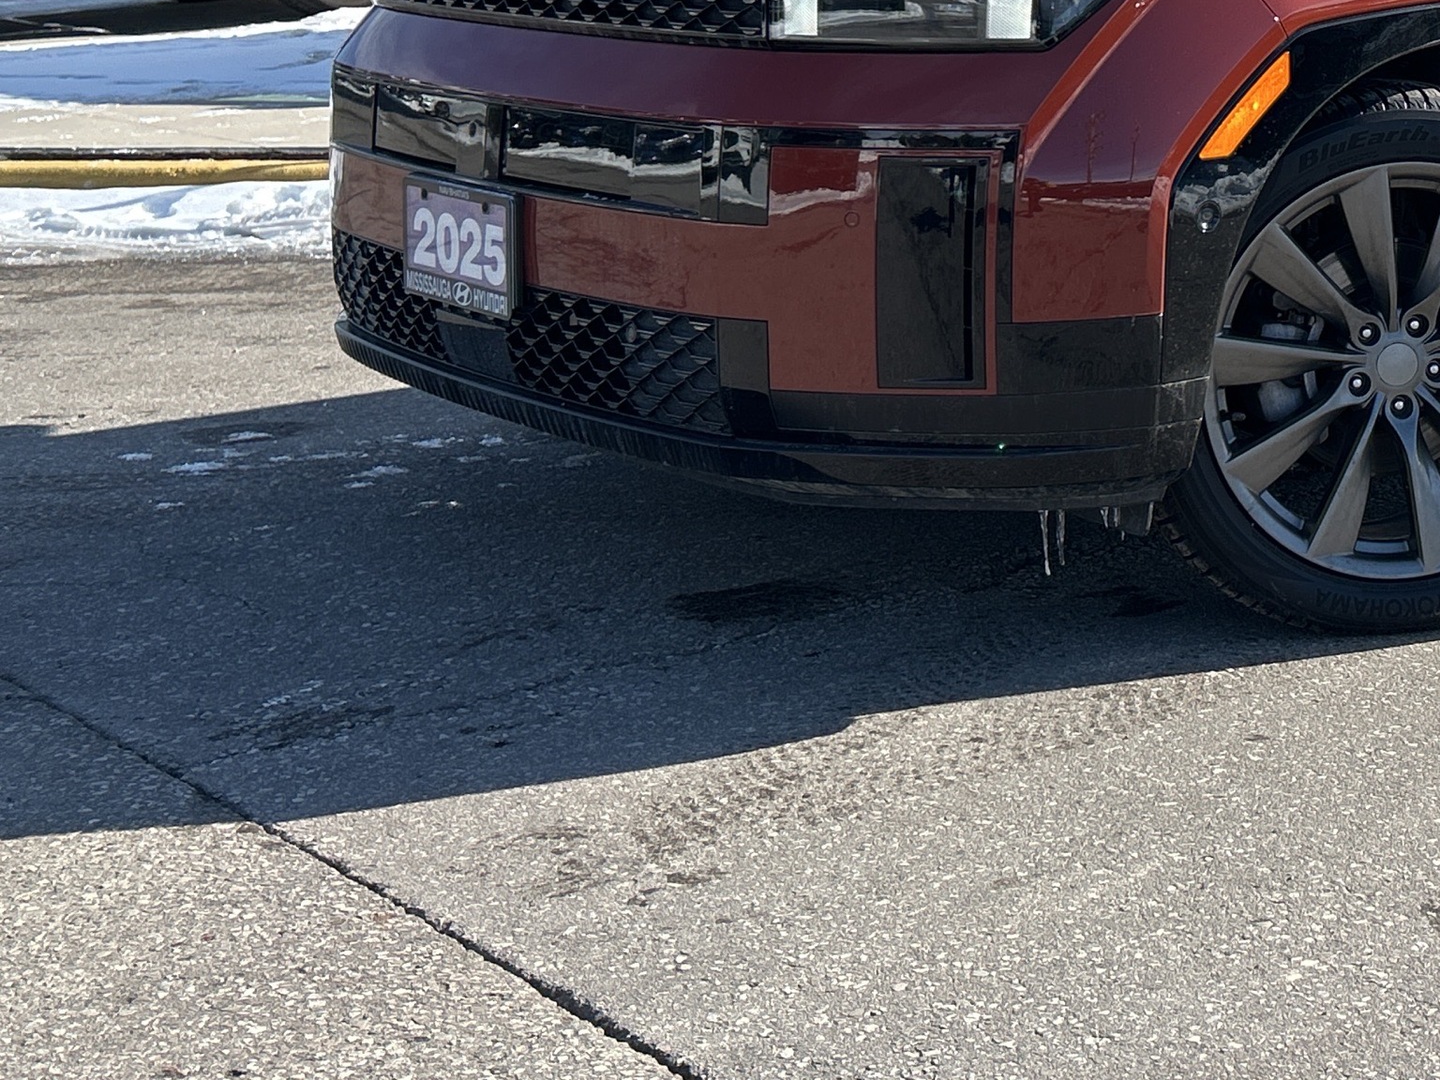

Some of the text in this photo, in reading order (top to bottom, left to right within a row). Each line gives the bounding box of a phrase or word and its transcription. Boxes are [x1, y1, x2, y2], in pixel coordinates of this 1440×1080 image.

[1299, 125, 1430, 173] BluEarth
[414, 207, 506, 286] 2025
[406, 270, 508, 316] MISSISSAUGA HYUNDAI
